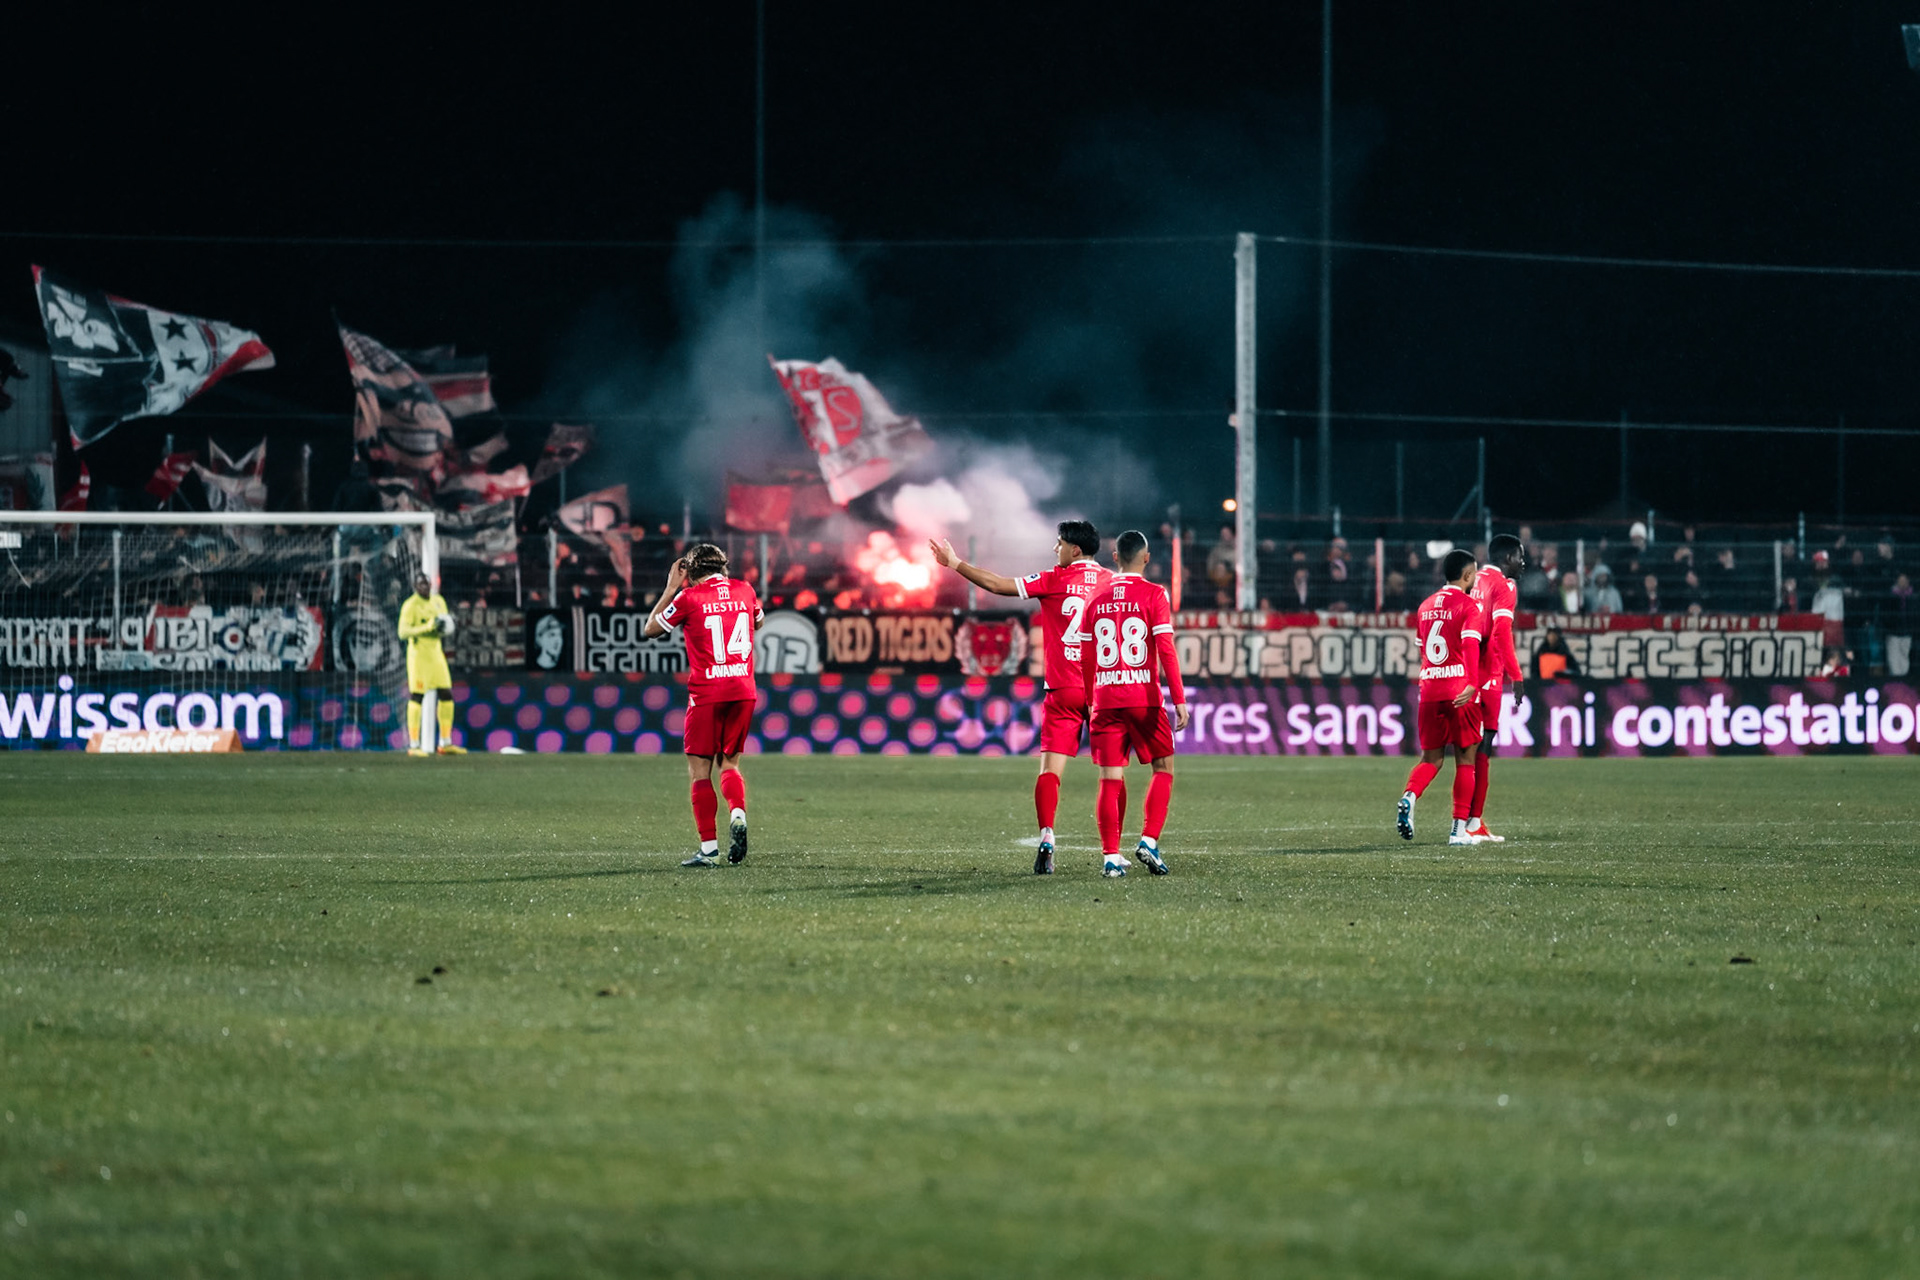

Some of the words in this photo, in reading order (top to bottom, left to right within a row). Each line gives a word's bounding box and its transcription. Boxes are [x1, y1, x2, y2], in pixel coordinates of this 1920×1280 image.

[702, 600, 748, 614] HESTIA
[1096, 602, 1141, 615] HESTIA
[1421, 609, 1453, 621] HESTIA
[704, 611, 753, 665] 14
[825, 616, 874, 663] RED
[875, 615, 954, 663] TIGERS
[1094, 616, 1148, 668] 88
[1290, 634, 1408, 677] POUR
[1425, 620, 1450, 666] 6
[1286, 703, 1406, 747] sans
[1549, 690, 1597, 748] ni
[1611, 687, 1920, 748] contestatio
